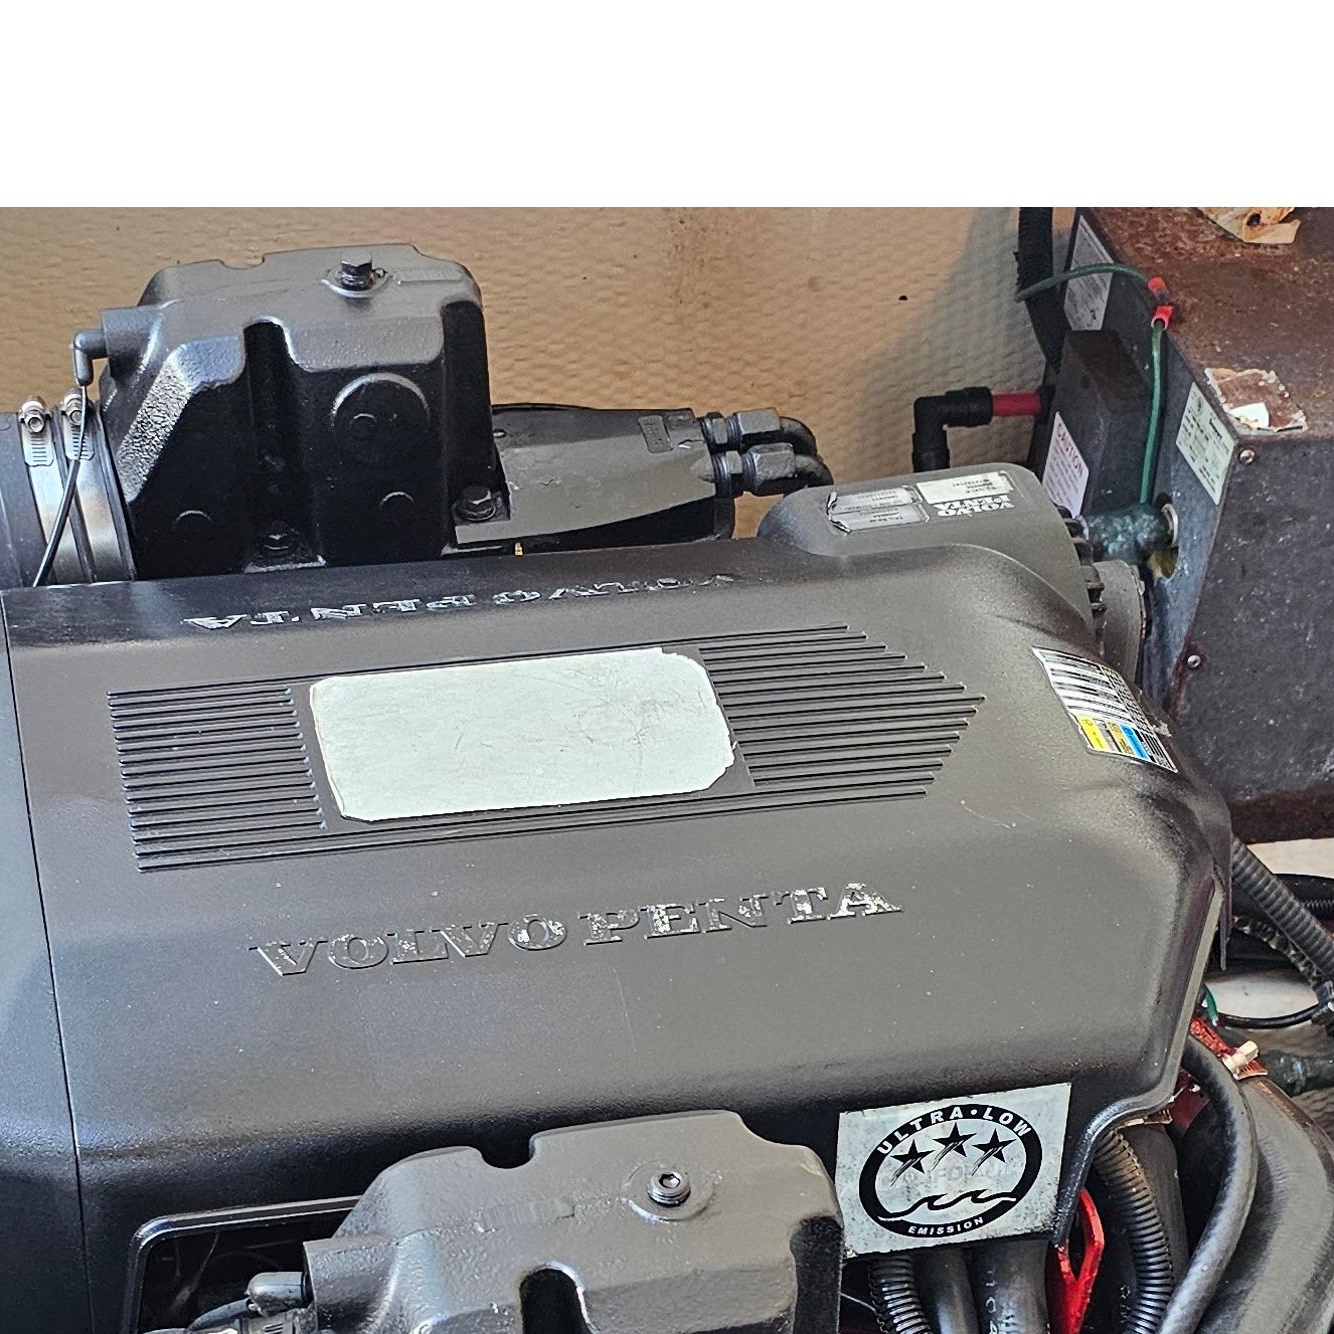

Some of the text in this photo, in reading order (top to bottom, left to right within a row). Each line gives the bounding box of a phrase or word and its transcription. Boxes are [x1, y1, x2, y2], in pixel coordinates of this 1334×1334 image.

[933, 494, 1009, 511] PENTA
[937, 501, 1015, 517] VOLVO
[181, 574, 734, 631] VOLVO PENTA
[249, 882, 904, 978] VOLVO PENTA
[877, 1106, 1033, 1155] ULTRA LOW
[908, 1217, 984, 1235] EMISSION
